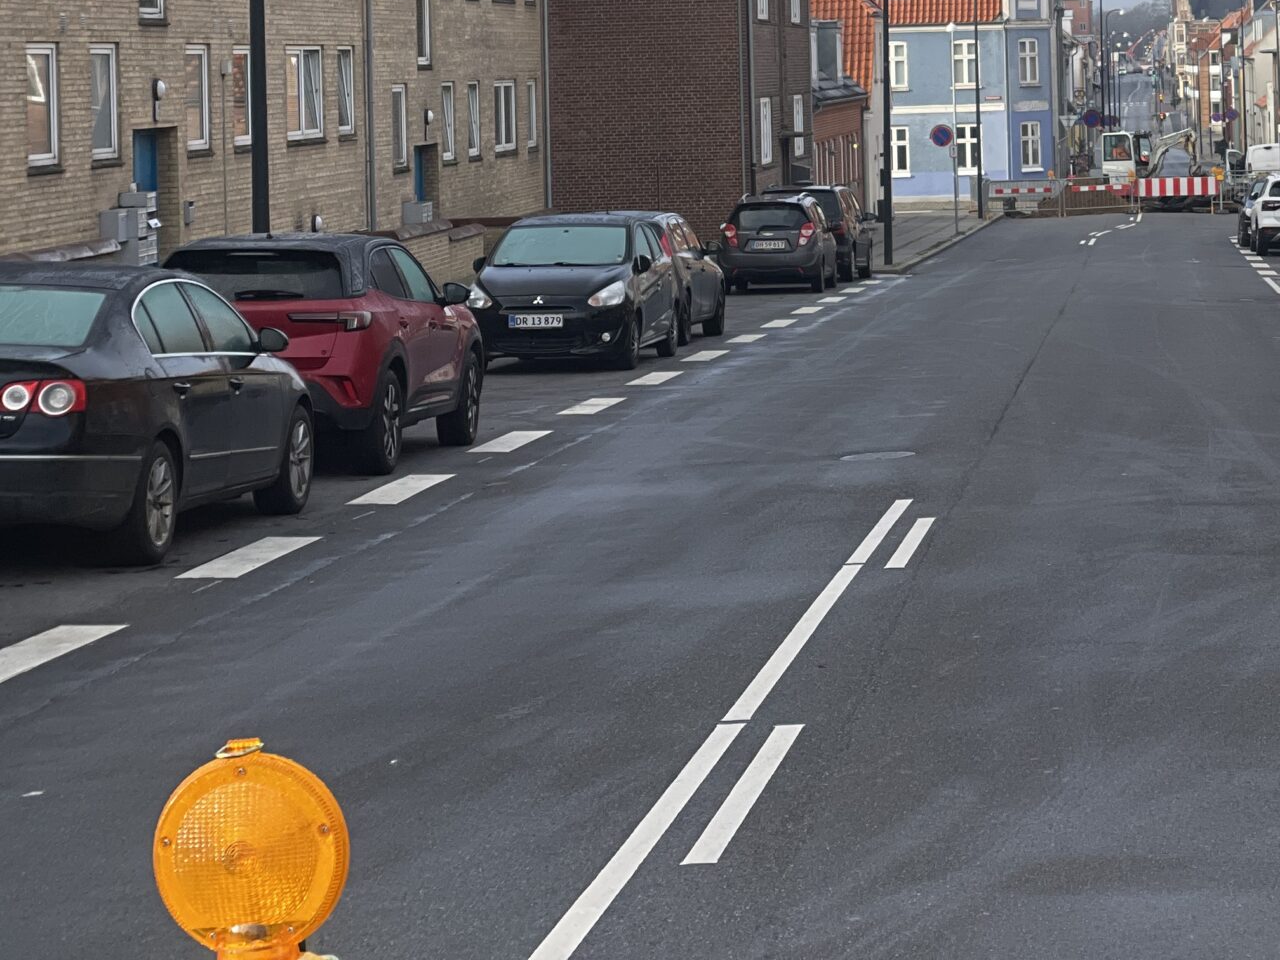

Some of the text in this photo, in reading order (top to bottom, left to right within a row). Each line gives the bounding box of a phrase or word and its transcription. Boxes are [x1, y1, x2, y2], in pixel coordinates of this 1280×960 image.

[515, 316, 561, 326] DR 13 879
